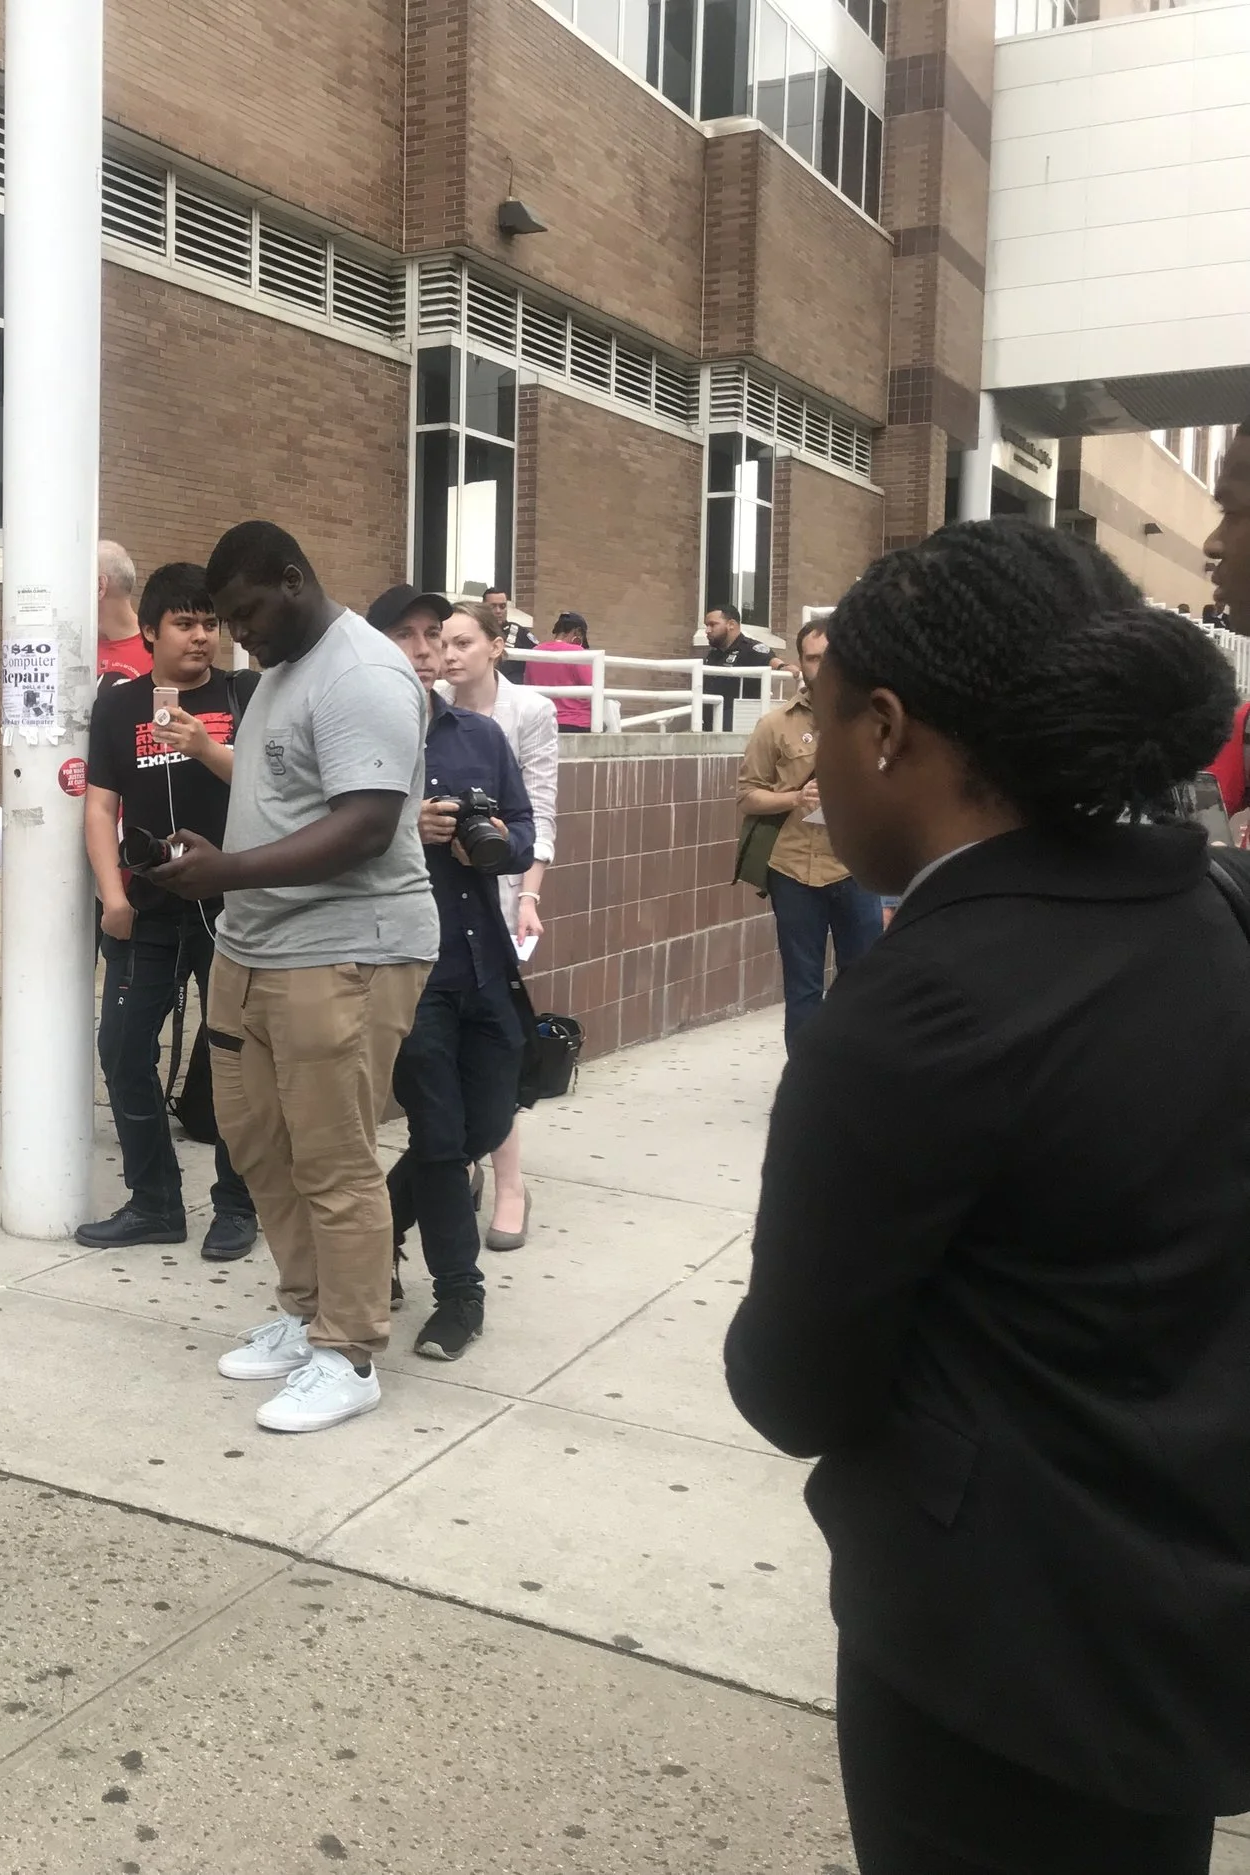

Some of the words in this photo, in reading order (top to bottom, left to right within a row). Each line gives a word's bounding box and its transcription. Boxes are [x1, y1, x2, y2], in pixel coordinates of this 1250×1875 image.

[11, 644, 51, 655] $40
[2, 656, 55, 670] Computer
[2, 667, 50, 687] Repair
